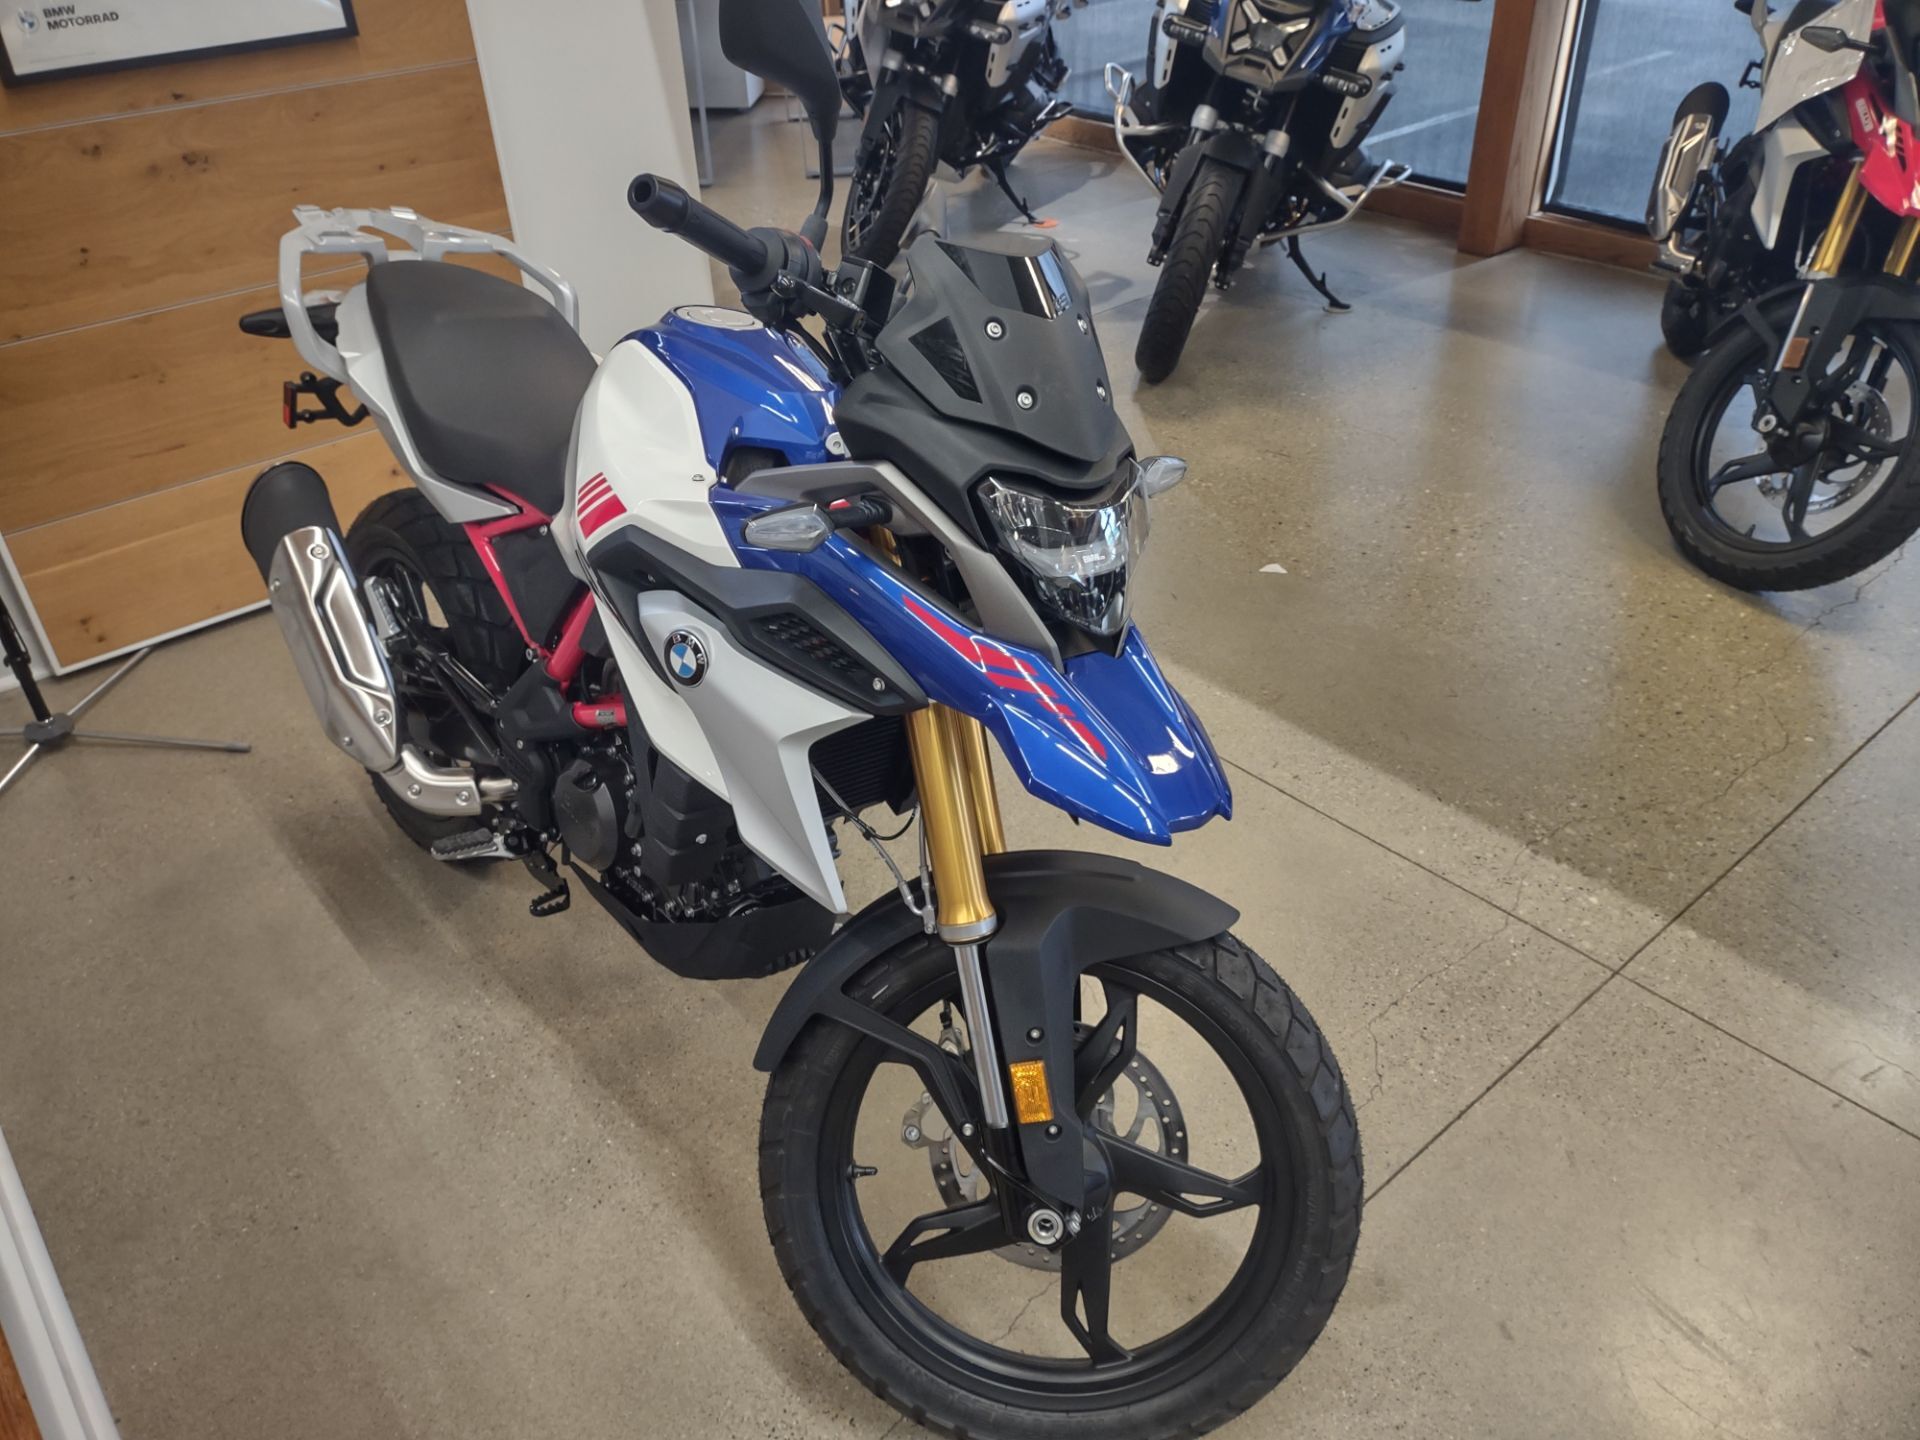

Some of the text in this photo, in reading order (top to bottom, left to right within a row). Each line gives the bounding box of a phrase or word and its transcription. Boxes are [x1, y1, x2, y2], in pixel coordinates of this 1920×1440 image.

[42, 5, 76, 18] BMW
[47, 11, 119, 30] MOTORRAD
[672, 633, 705, 664] BMW
